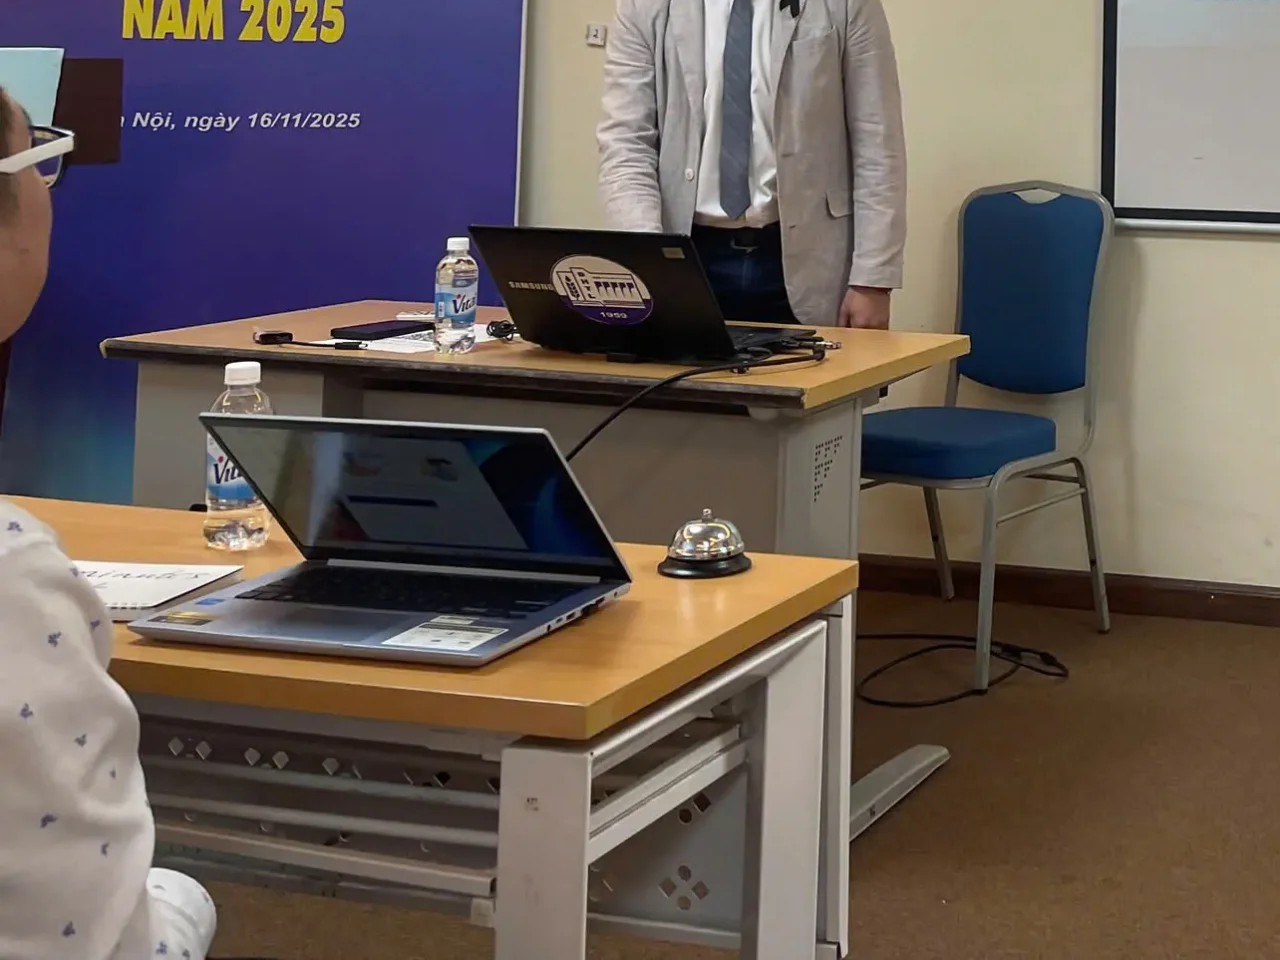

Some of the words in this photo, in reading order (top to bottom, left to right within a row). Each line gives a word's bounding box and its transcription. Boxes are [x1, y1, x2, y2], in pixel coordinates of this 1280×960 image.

[132, 112, 176, 131] Nội,
[184, 112, 240, 132] ngày
[248, 112, 360, 129] 16/11/2025
